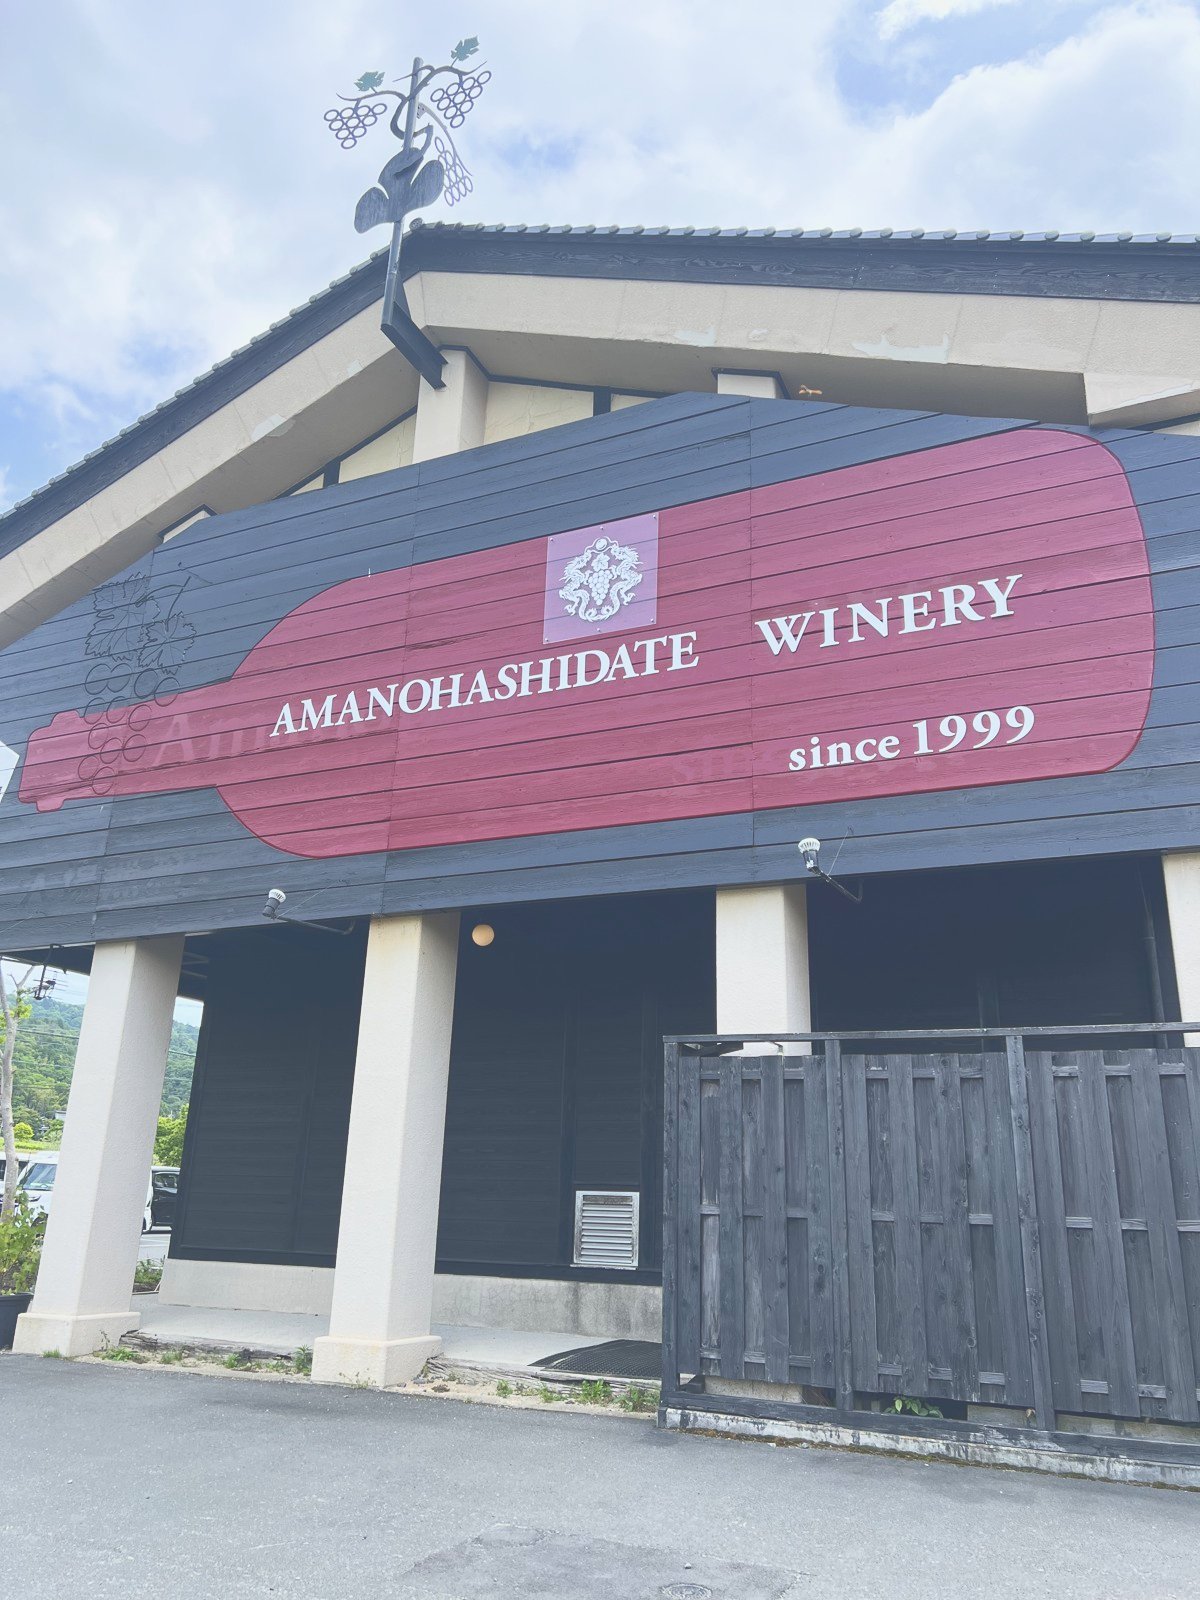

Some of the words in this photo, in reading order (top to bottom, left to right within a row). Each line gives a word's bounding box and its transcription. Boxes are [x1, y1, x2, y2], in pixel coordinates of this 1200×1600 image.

[269, 630, 700, 739] AMANOHASHIDATE
[754, 573, 1023, 656] WINERY
[788, 735, 901, 772] since
[911, 705, 1036, 756] 1999
